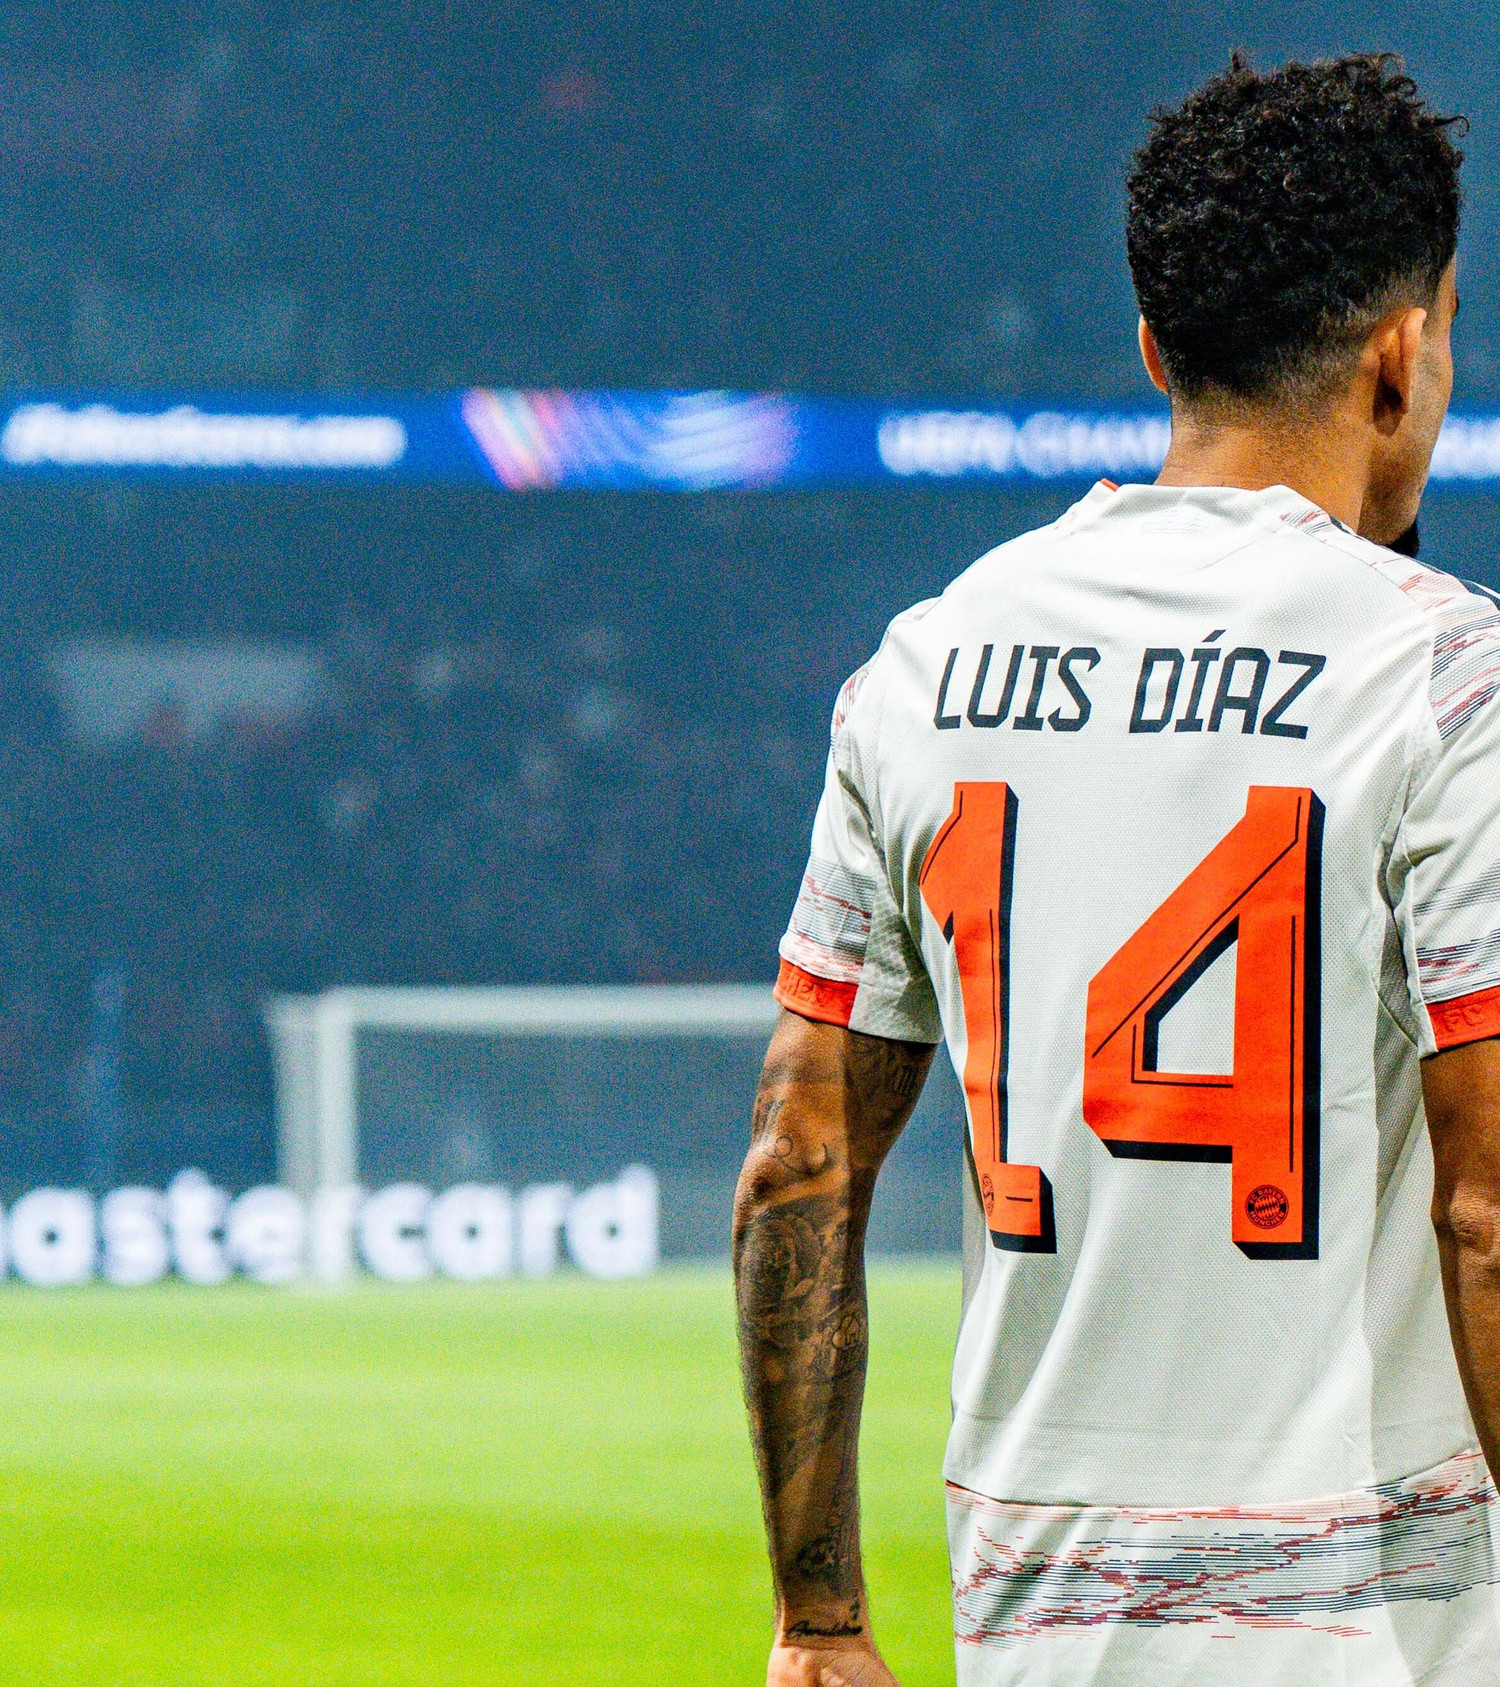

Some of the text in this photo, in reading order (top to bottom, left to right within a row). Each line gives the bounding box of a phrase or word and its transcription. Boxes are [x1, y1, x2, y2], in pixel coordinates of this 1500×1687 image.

[933, 629, 1327, 740] LUIS DÍAZ
[918, 781, 1327, 1261] 14
[0, 1164, 658, 1287] astercard
